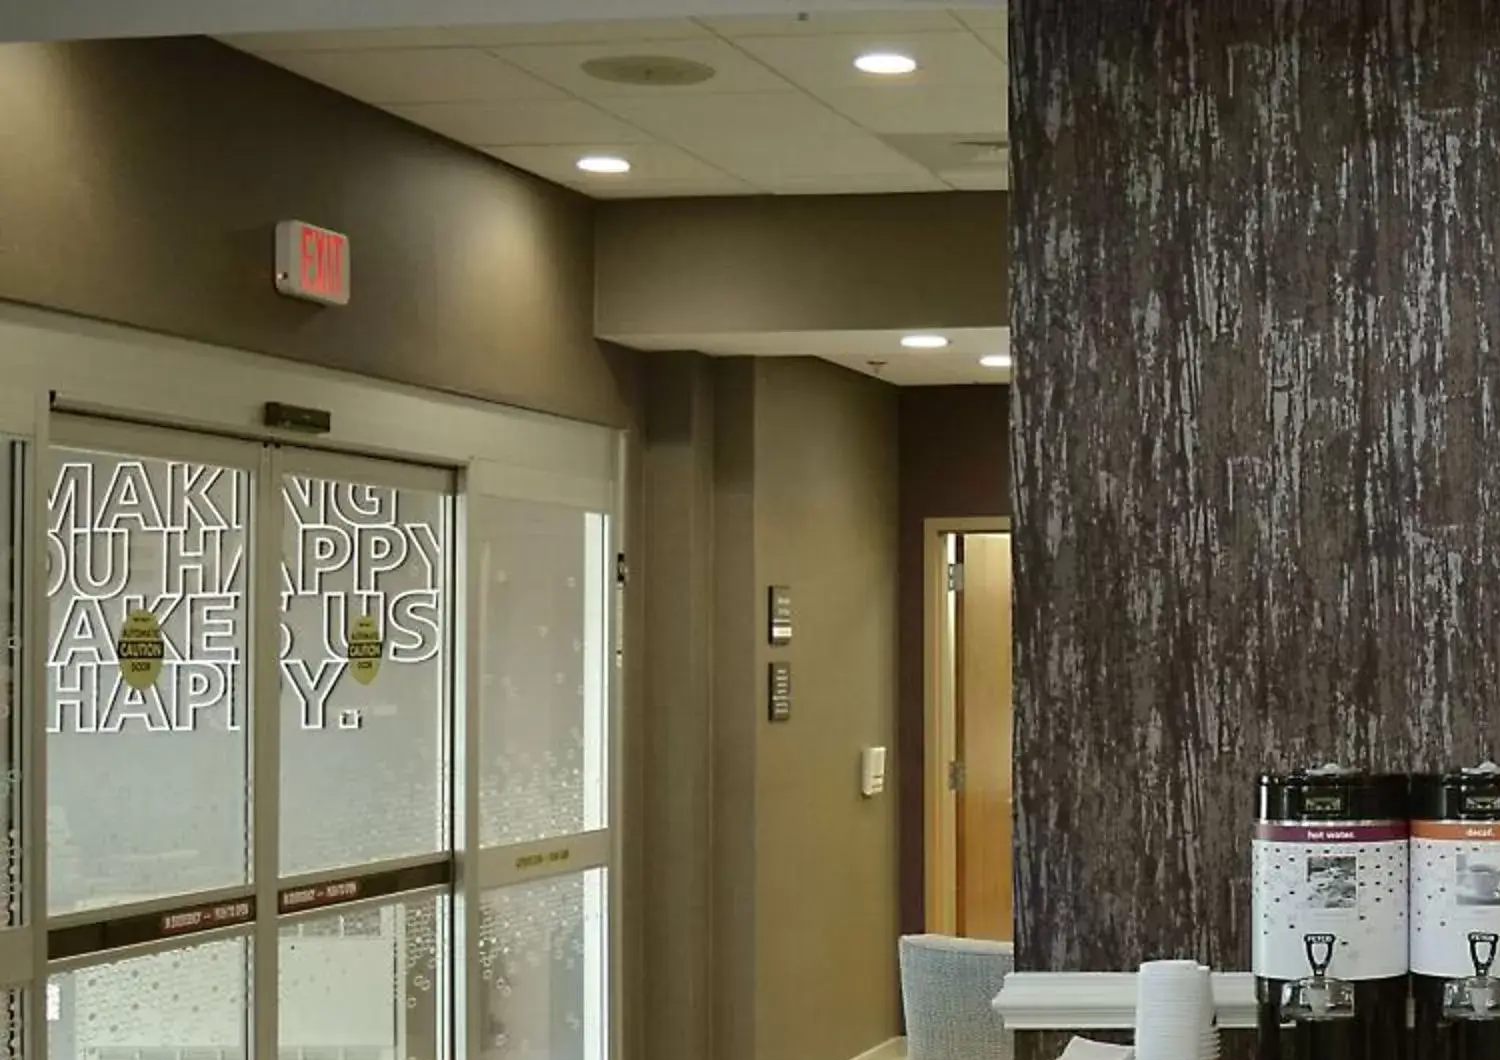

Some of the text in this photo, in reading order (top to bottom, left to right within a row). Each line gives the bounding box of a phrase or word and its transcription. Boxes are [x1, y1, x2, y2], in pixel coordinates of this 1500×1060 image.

[301, 225, 344, 292] EXIT
[323, 590, 440, 663] US
[120, 642, 162, 657] CAUTION
[1307, 830, 1324, 840] hot
